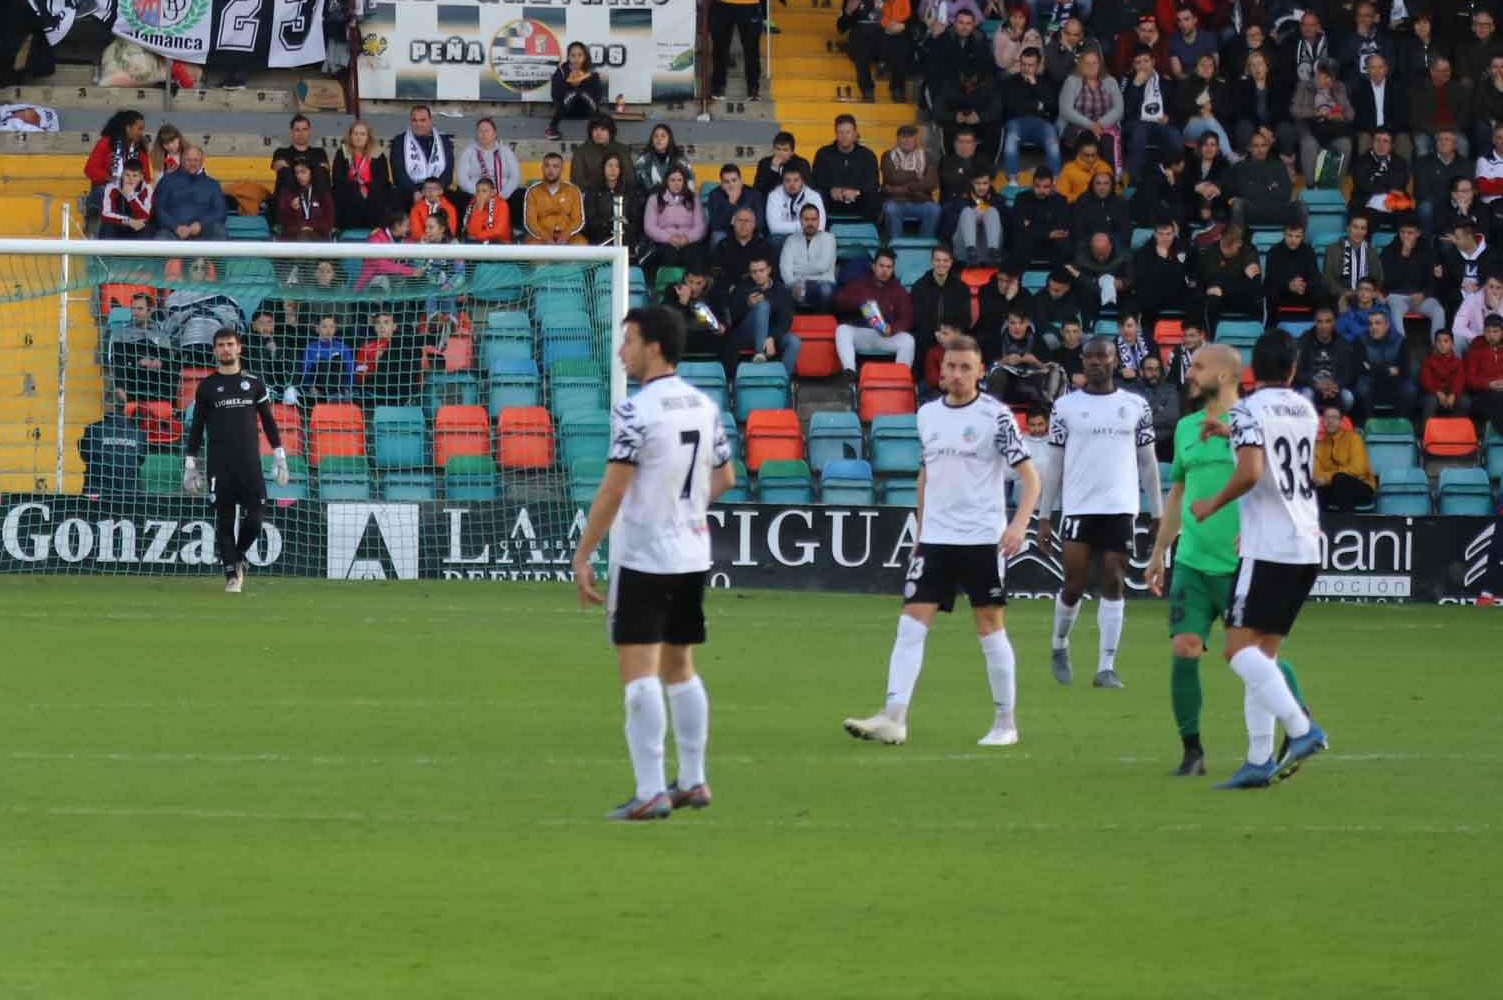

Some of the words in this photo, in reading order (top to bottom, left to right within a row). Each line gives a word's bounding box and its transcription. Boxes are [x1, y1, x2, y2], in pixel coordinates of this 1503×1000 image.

[410, 36, 485, 66] PEÑA
[680, 430, 700, 499] 7
[1273, 436, 1315, 501] 33
[1, 502, 283, 566] Gonzao
[552, 507, 918, 568] AIGUA
[1311, 577, 1406, 595] moción
